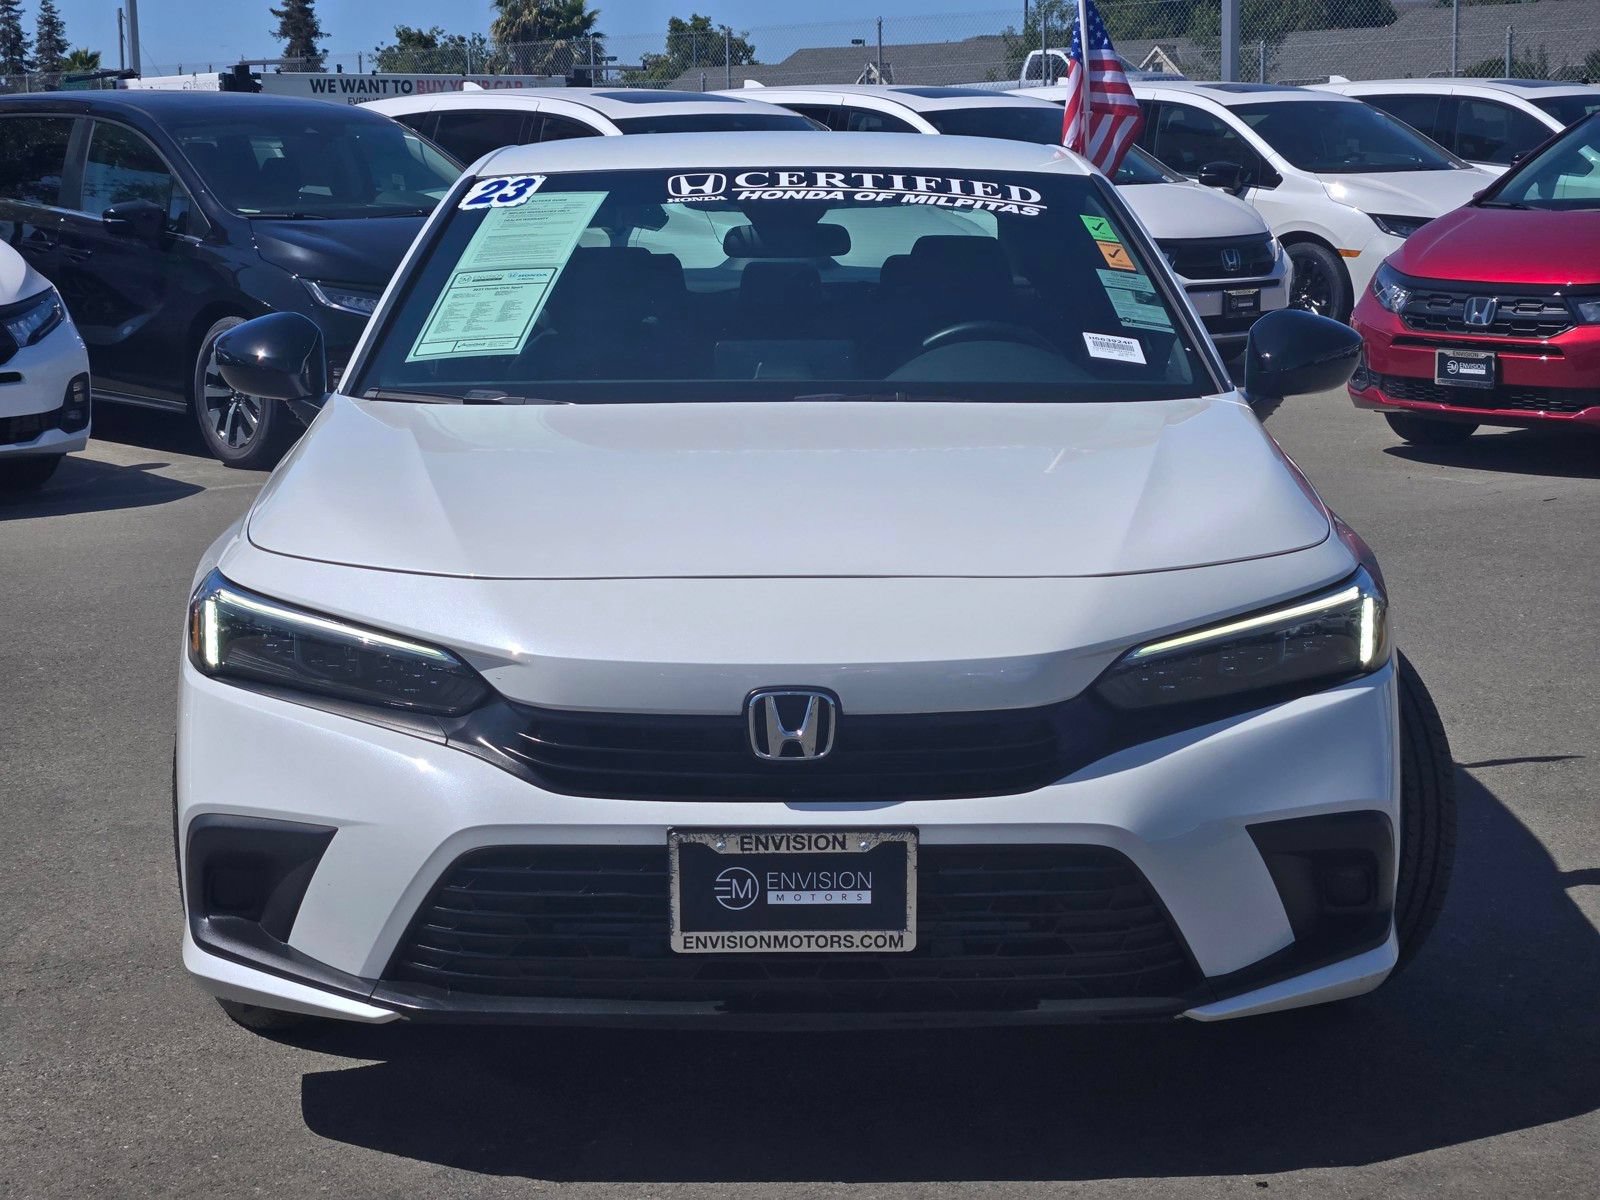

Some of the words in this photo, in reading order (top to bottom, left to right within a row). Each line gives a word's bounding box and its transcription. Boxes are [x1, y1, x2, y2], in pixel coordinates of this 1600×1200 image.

[309, 79, 336, 94] WE
[341, 79, 389, 94] WANT
[392, 79, 413, 94] TO
[416, 79, 447, 95] BUY
[466, 178, 536, 205] 23
[734, 171, 1042, 204] CERTIFIED
[667, 195, 728, 204] HONDA
[736, 189, 845, 201] HONDA
[862, 191, 895, 203] OF
[900, 192, 1041, 217] MILPITAS
[1459, 362, 1486, 370] ENVISION
[739, 835, 847, 852] ENVISION
[767, 871, 872, 890] ENVISION
[683, 934, 904, 950] ENVISIONMOTORS.COM
